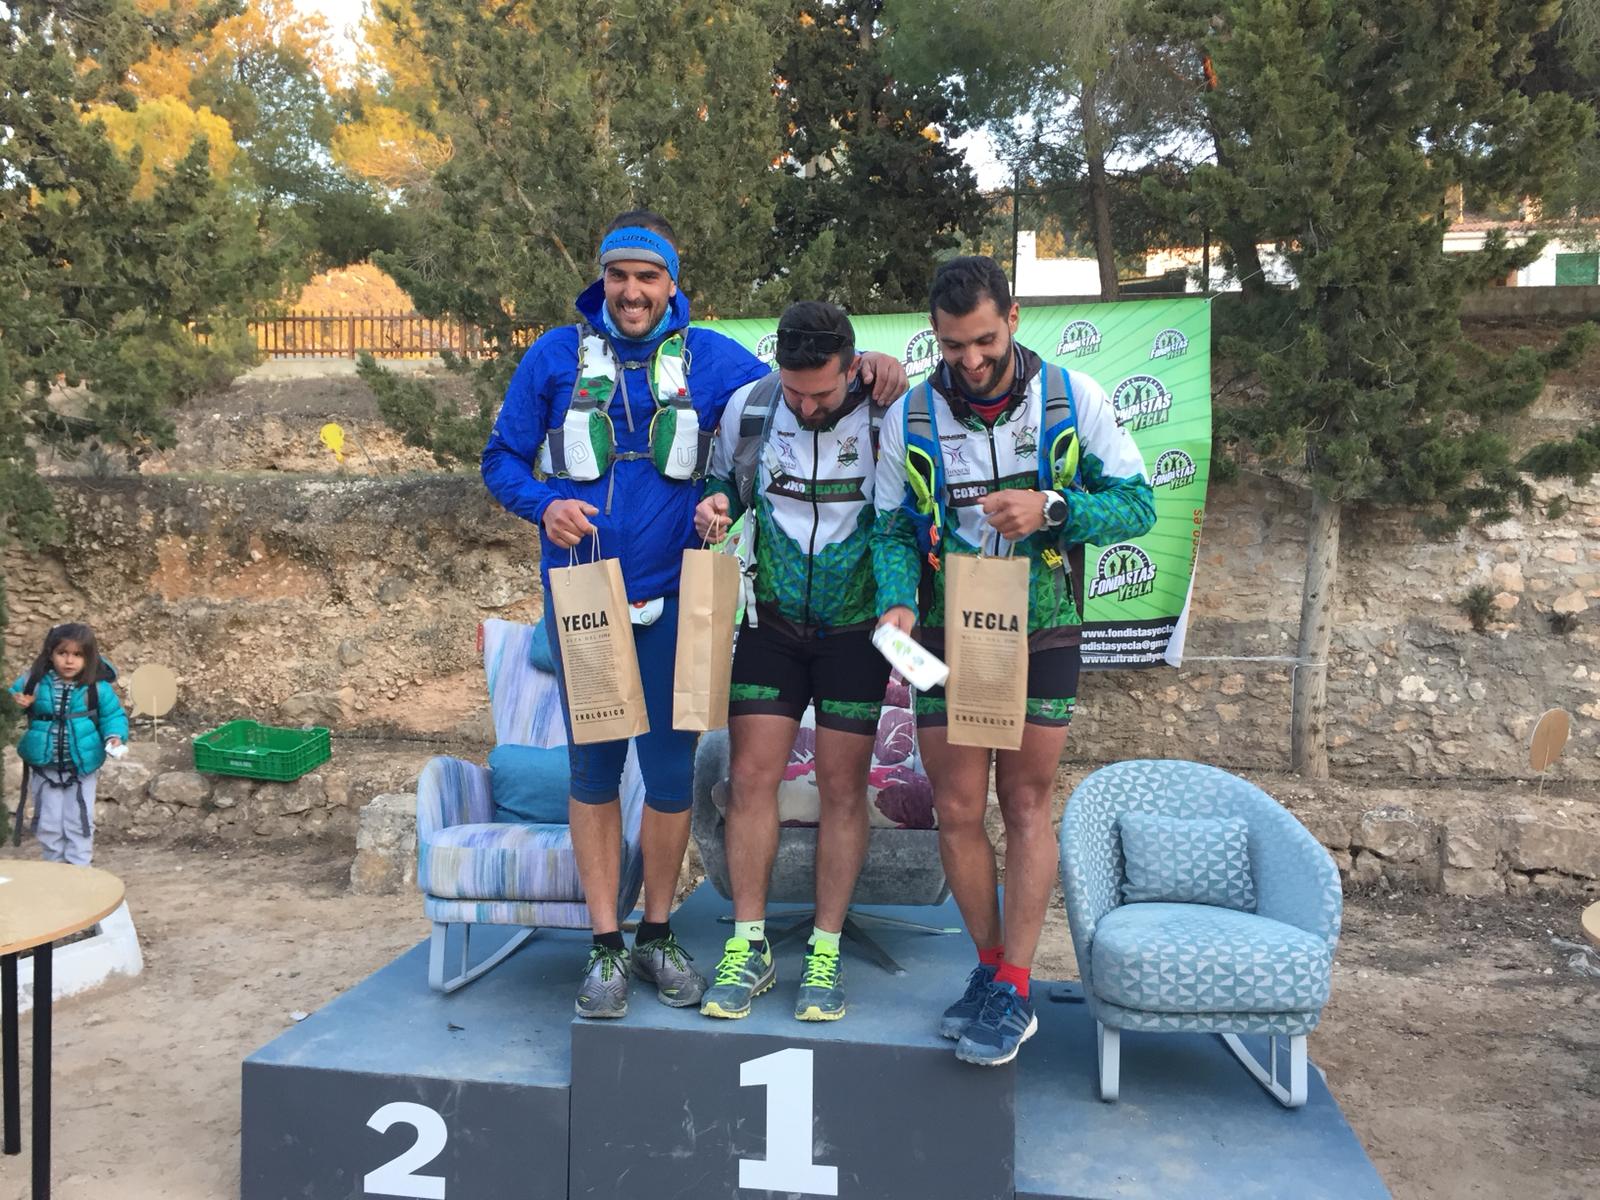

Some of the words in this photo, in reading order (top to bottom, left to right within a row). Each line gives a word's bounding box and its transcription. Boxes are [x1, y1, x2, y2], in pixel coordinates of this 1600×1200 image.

[1056, 334, 1102, 356] FONDISTAS
[1132, 409, 1168, 431] YECLA
[1151, 464, 1197, 488] FONDISTAS
[1169, 476, 1194, 490] YECLA
[1088, 564, 1157, 599] FONDISTAS
[1118, 580, 1154, 601] YECLA
[562, 610, 609, 632] YECLA
[962, 610, 1019, 632] YECLA
[738, 1048, 838, 1196] 1
[364, 1101, 448, 1200] 2
